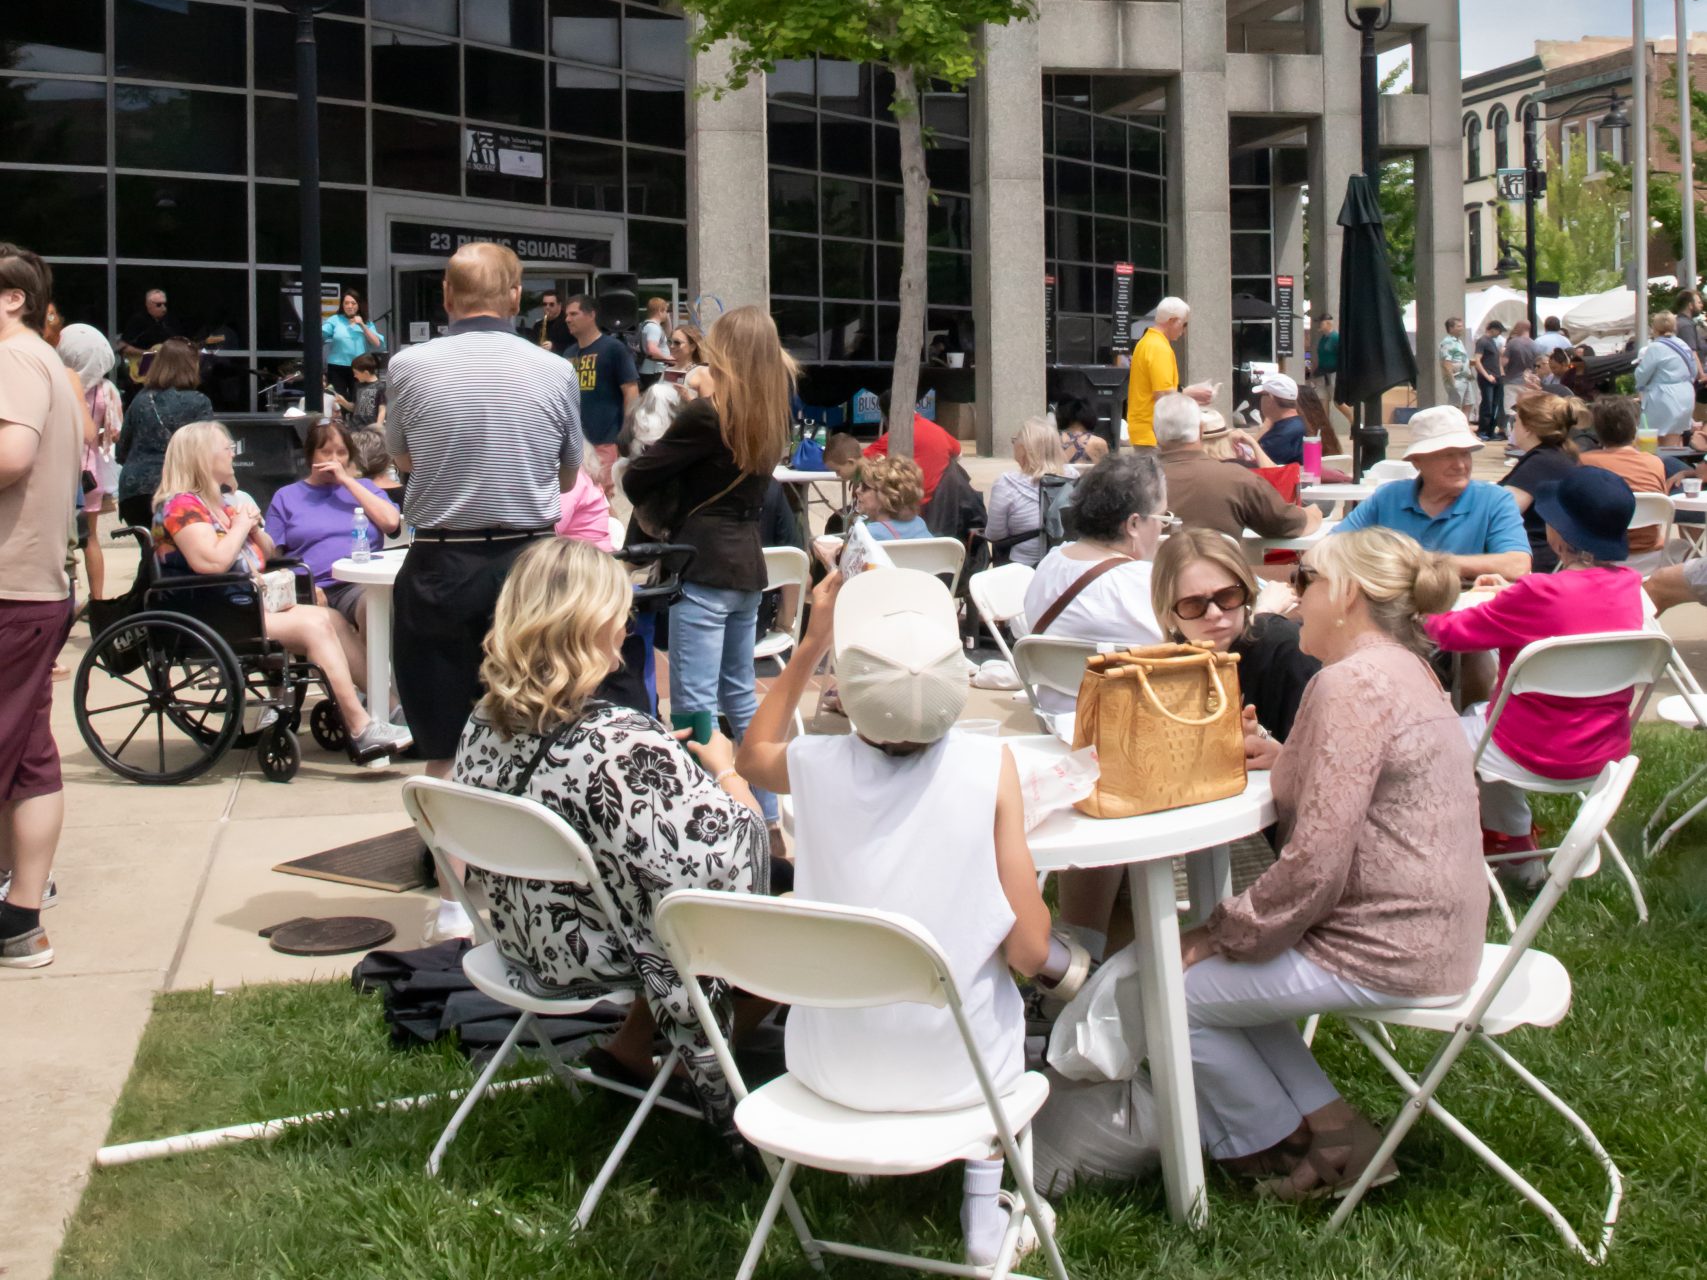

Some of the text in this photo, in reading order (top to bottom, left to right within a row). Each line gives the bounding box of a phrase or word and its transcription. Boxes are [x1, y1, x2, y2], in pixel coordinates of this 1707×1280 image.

[430, 232, 451, 250] 23
[517, 239, 577, 260] SQUARE
[858, 396, 881, 413] BUSC
